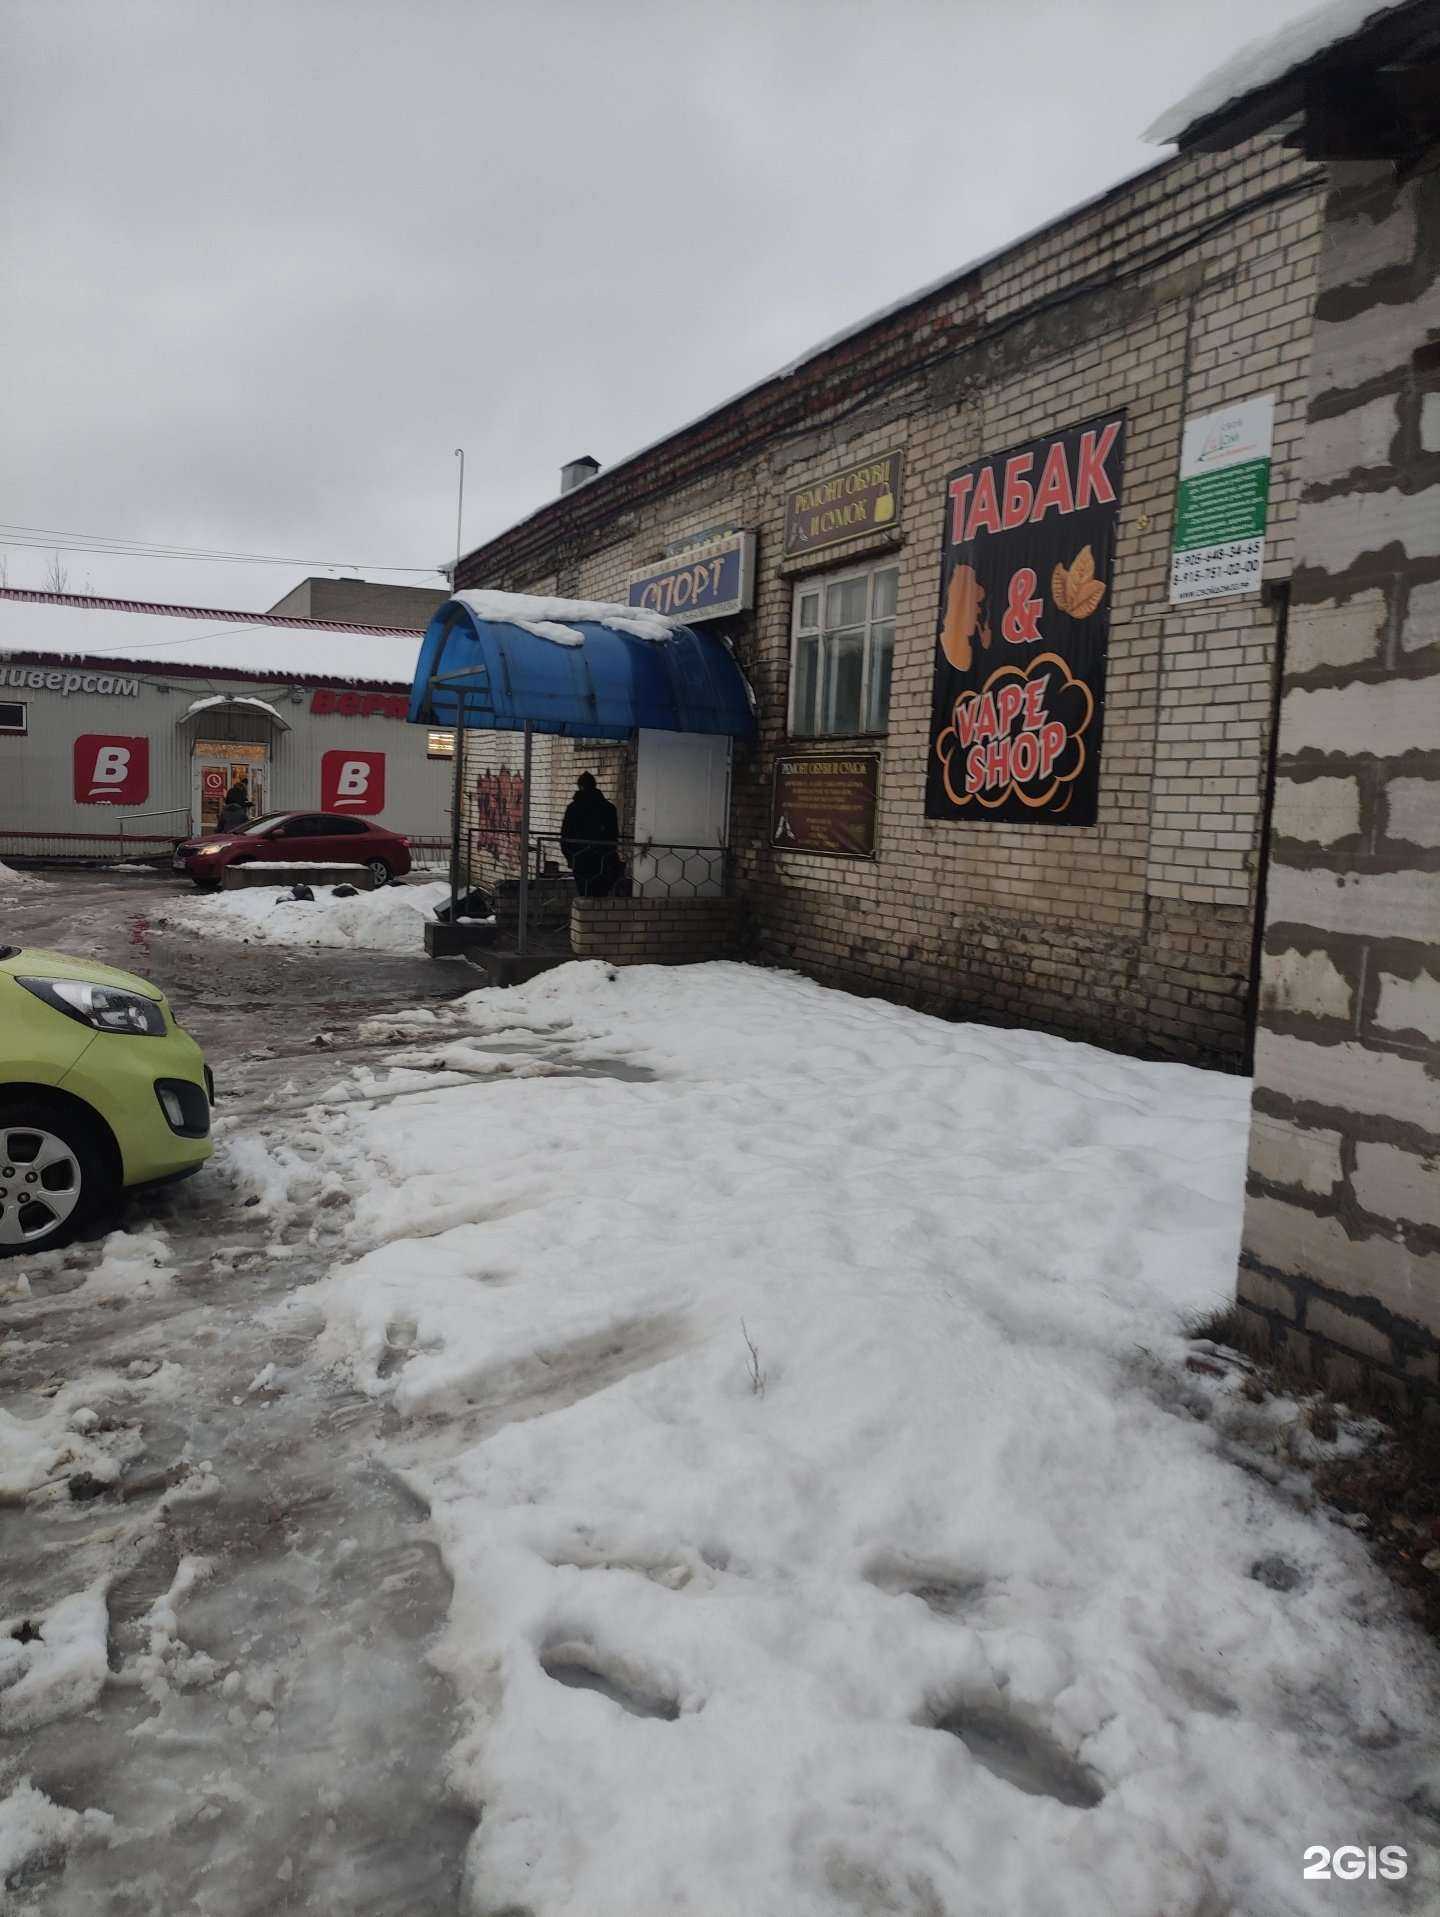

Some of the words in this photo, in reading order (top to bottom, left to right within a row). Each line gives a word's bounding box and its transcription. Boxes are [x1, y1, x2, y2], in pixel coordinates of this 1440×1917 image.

[949, 421, 1122, 545] ТАБАК
[956, 673, 1051, 748] VAPE
[965, 721, 1067, 793] SHOP
